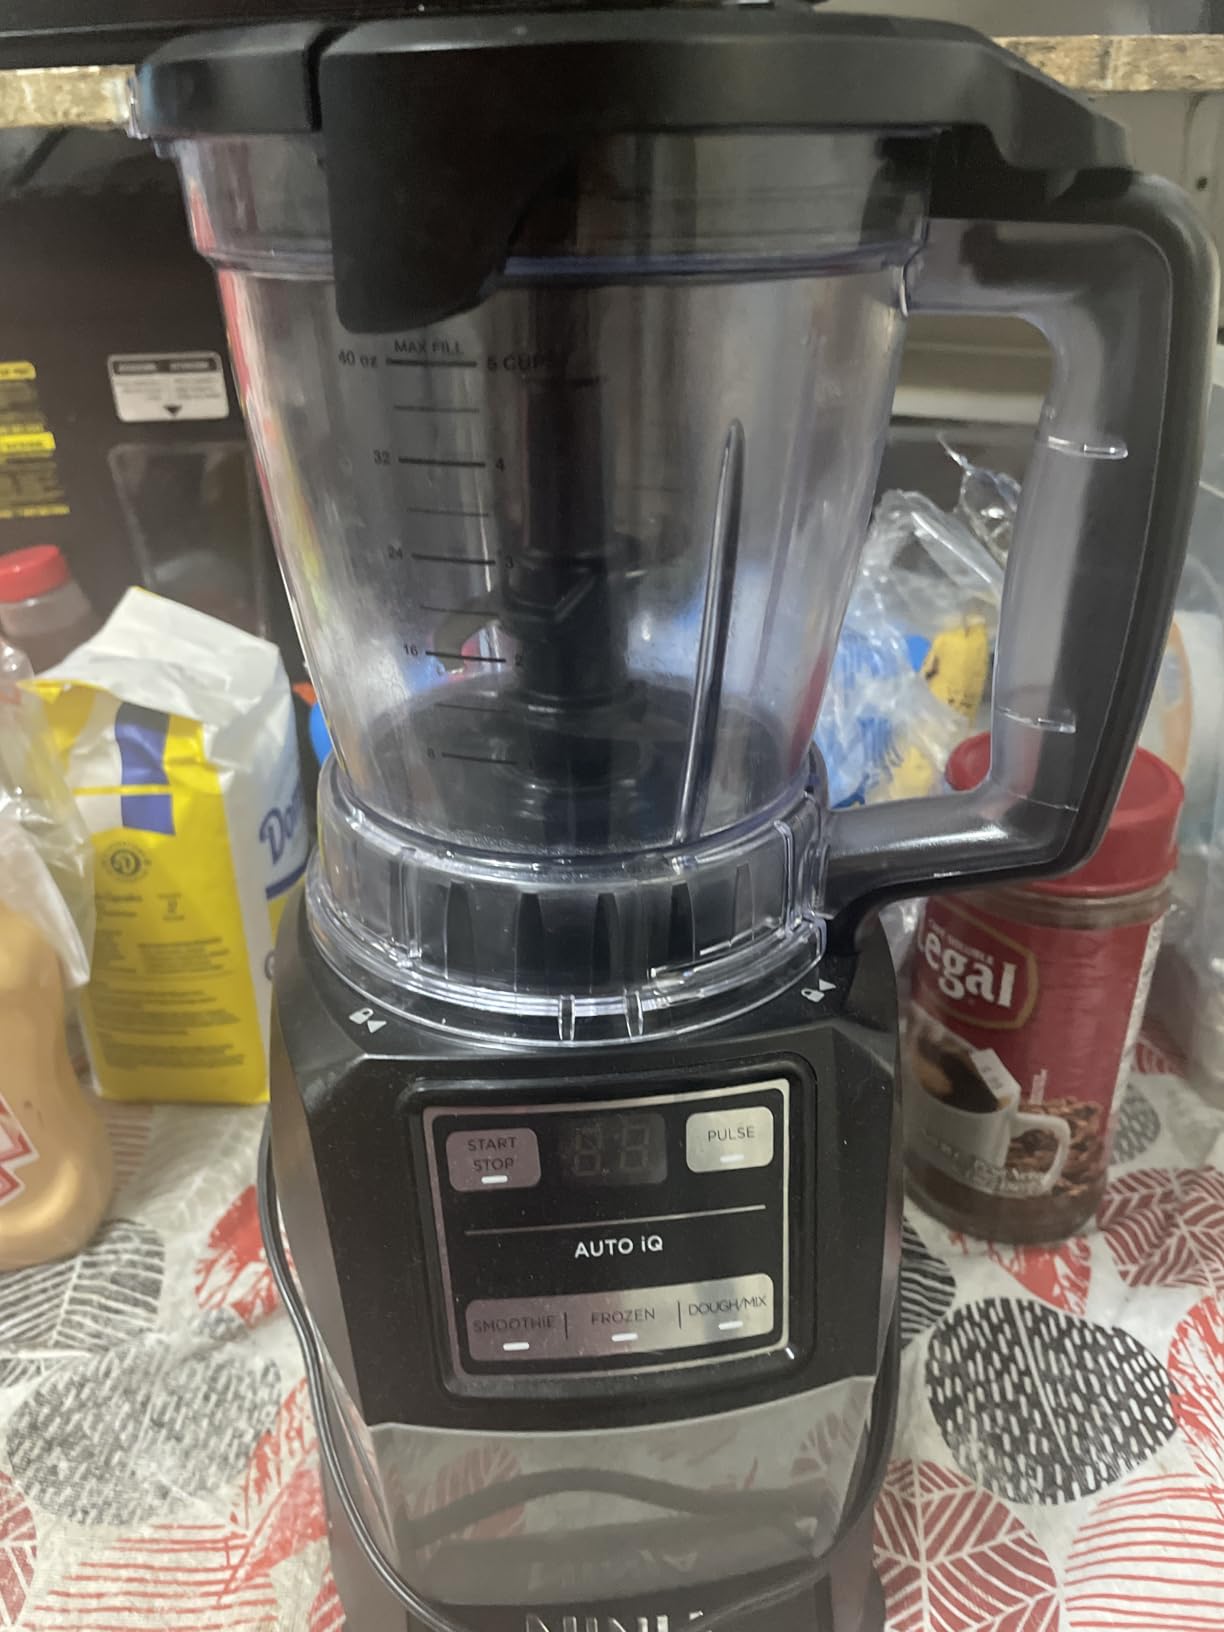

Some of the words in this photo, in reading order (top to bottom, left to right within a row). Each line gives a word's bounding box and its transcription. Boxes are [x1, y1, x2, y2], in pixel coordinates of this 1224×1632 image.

[394, 339, 428, 353] MAX
[432, 340, 461, 353] FILL
[338, 349, 355, 367] 40
[486, 357, 498, 372] 5
[372, 449, 390, 466] 32
[495, 457, 505, 472] 4
[388, 545, 404, 560] 24
[504, 555, 515, 569] 3
[403, 643, 419, 657] 16
[707, 1125, 756, 1142] PULSE
[467, 1136, 517, 1152] START
[472, 1157, 515, 1172] STOP
[574, 1237, 634, 1259] AUTO
[641, 1235, 664, 1252] iQ
[688, 1295, 768, 1317] DOUGH/MIX
[472, 1315, 556, 1333] SMOOTHIE
[591, 1307, 656, 1326] FROZEN
